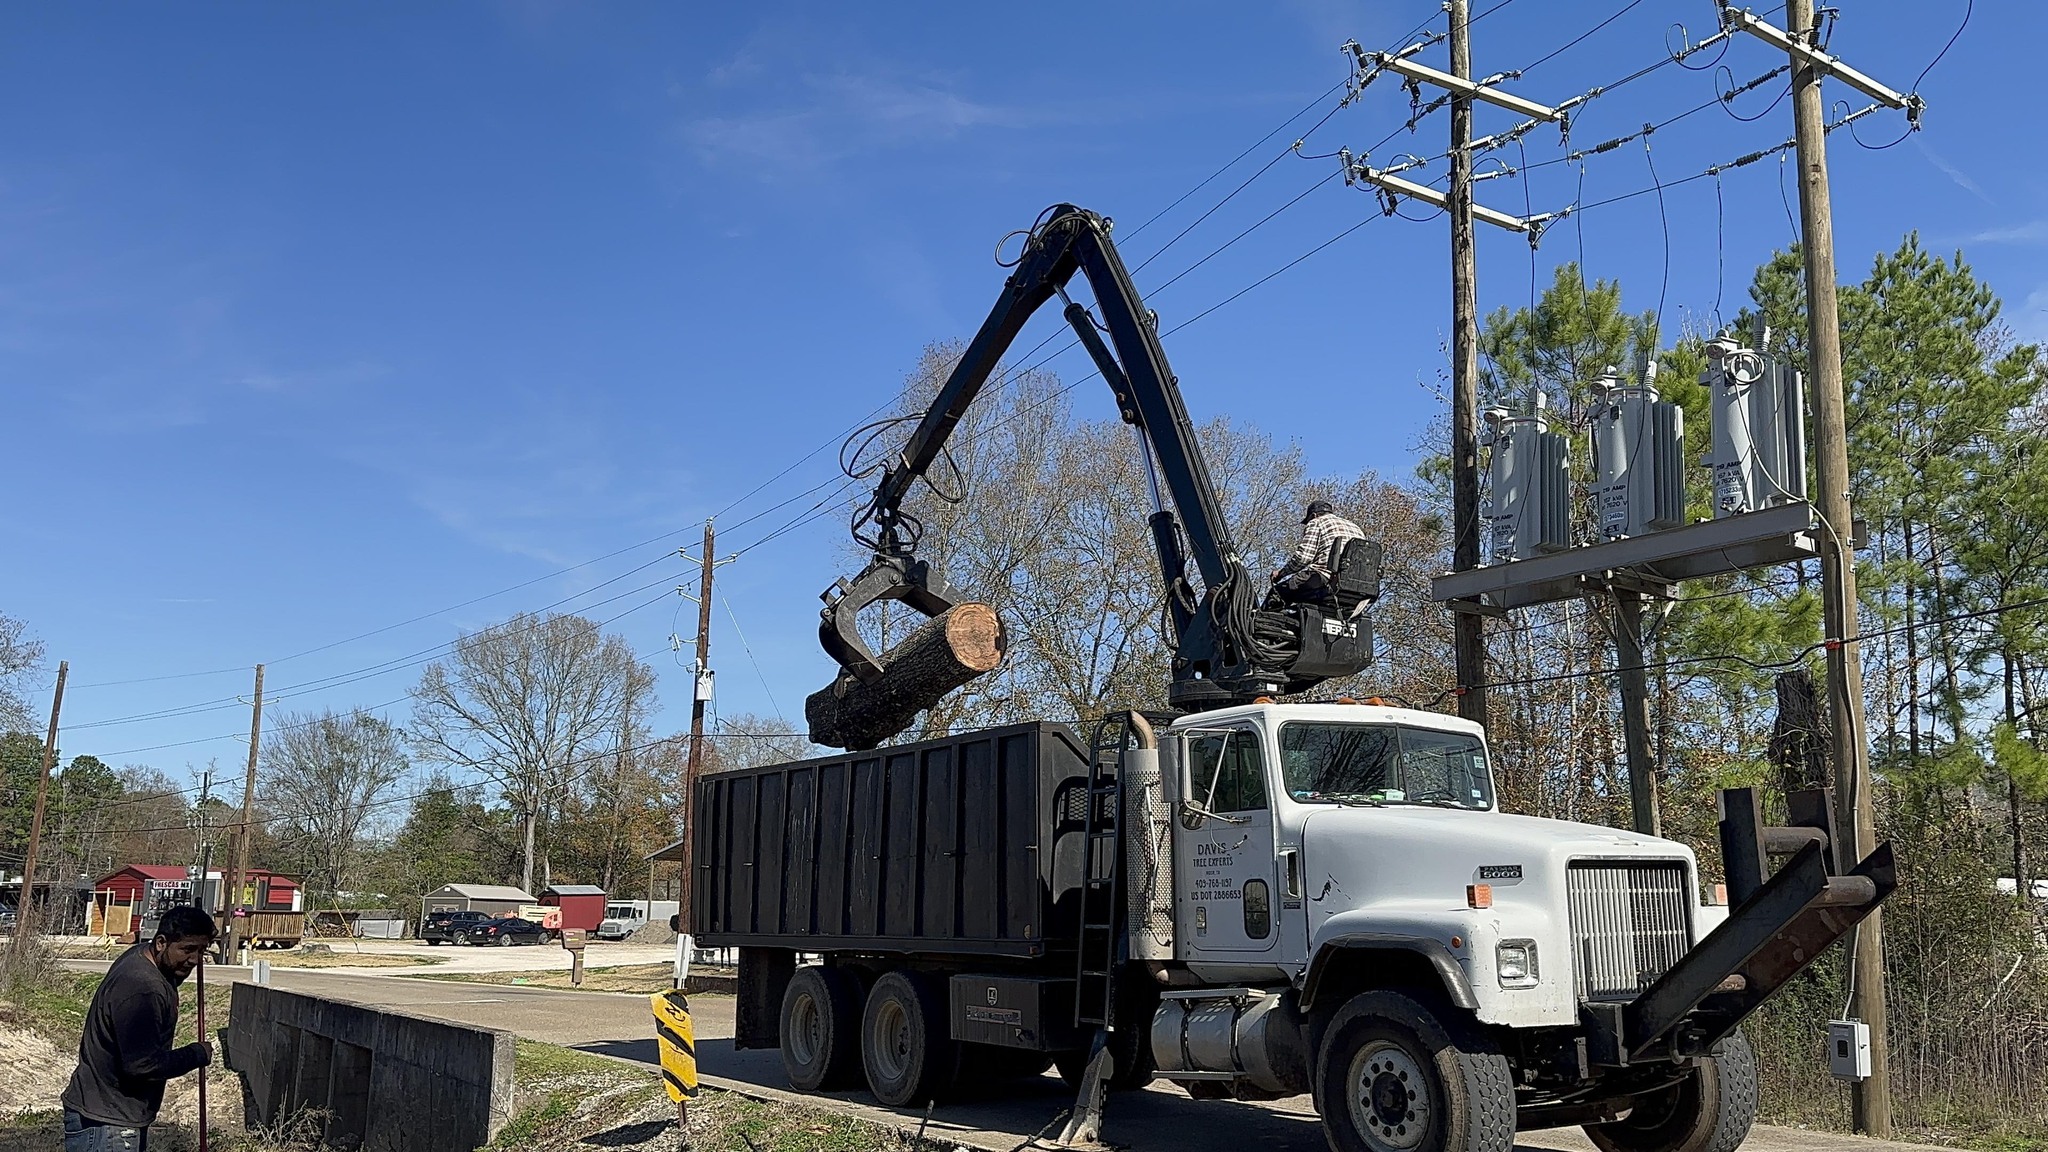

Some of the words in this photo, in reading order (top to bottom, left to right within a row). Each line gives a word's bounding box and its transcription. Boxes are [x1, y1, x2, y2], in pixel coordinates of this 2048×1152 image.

[1611, 484, 1626, 492] AMP
[1197, 842, 1227, 855] DAVIS
[1192, 858, 1207, 867] TREE
[1208, 856, 1234, 867] EXPERTS
[1190, 891, 1199, 900] US
[1200, 890, 1213, 900] DOT
[1213, 889, 1242, 900] 2886653
